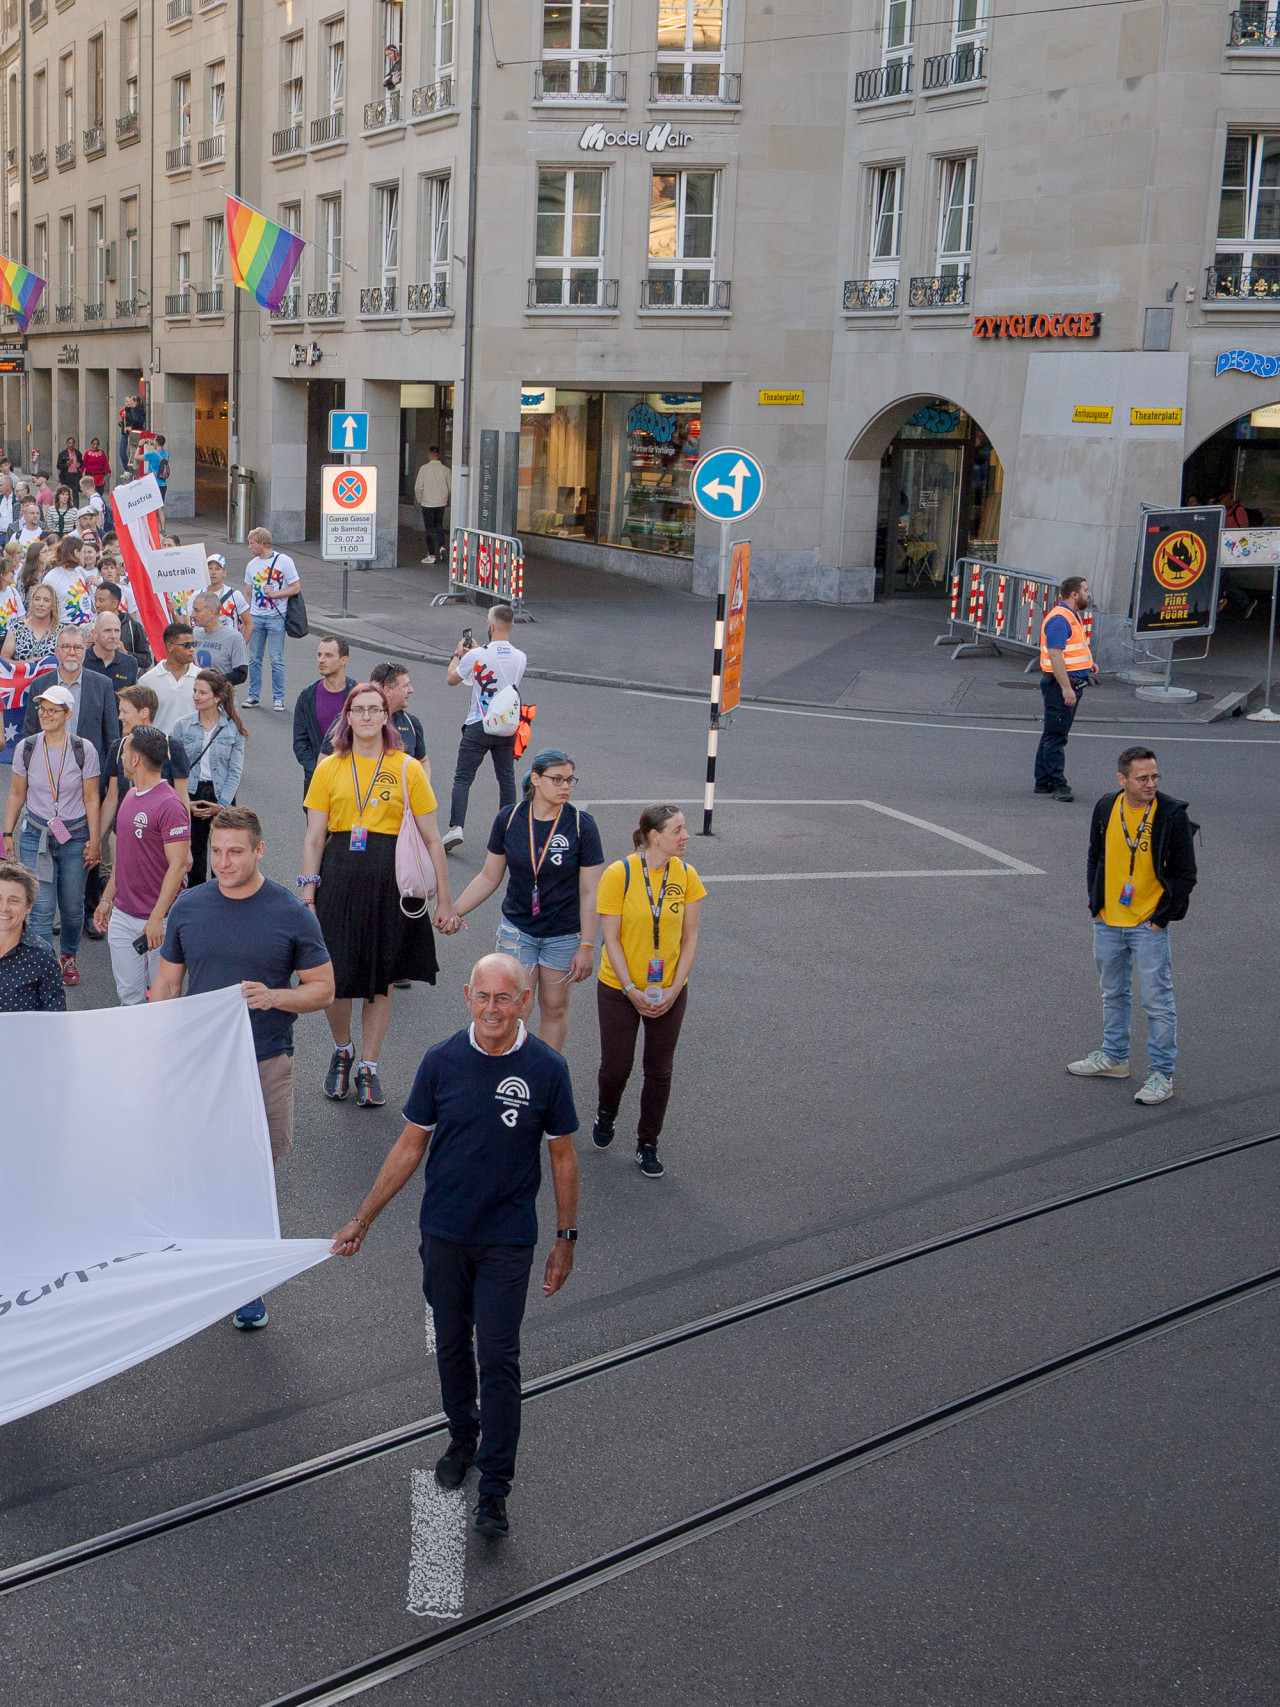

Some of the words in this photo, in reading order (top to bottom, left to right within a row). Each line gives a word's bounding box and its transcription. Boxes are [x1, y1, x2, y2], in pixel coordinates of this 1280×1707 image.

[579, 122, 643, 151] Model
[645, 122, 694, 151] Hair
[972, 313, 1095, 337] ZYTGLOGGE
[763, 392, 801, 403] Theaterplatz
[1134, 410, 1179, 422] Theaterplatz
[127, 492, 153, 509] Austria
[333, 535, 365, 543] 29.07.23
[157, 567, 196, 578] Australia
